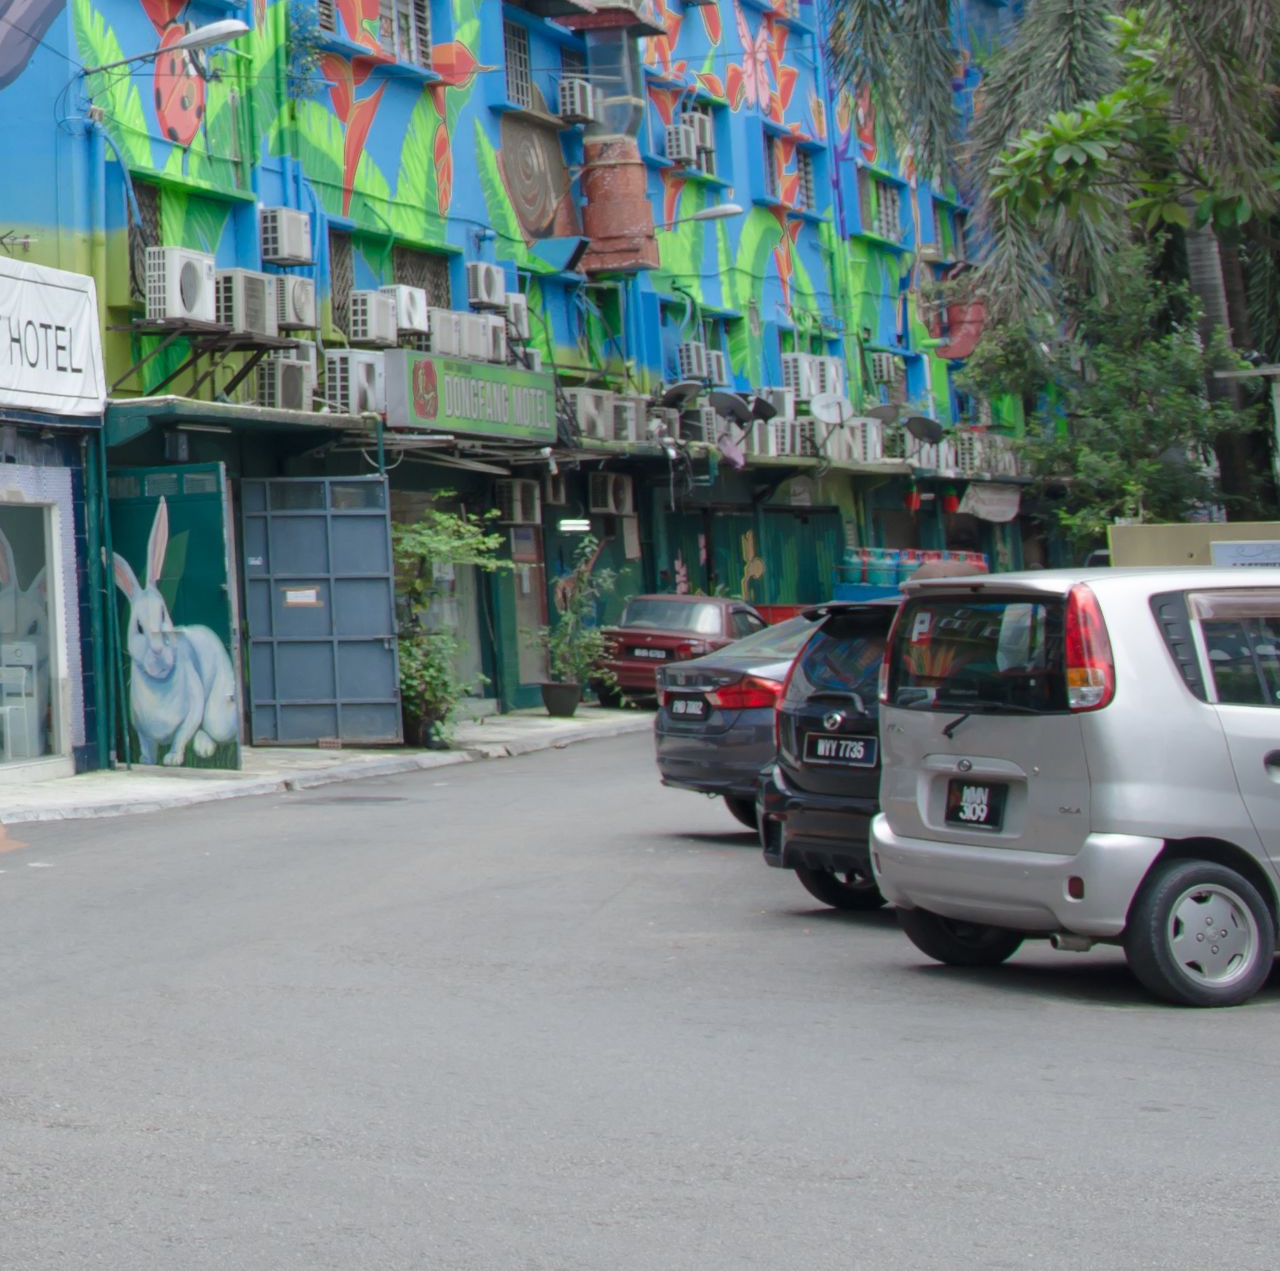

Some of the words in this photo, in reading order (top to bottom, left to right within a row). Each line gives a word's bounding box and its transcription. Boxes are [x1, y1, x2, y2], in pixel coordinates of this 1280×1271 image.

[8, 316, 83, 374] HOTEL
[444, 375, 510, 424] DONGFANG
[512, 385, 550, 428] MOTEL
[839, 740, 865, 759] 7735
[959, 802, 988, 822] 3109
